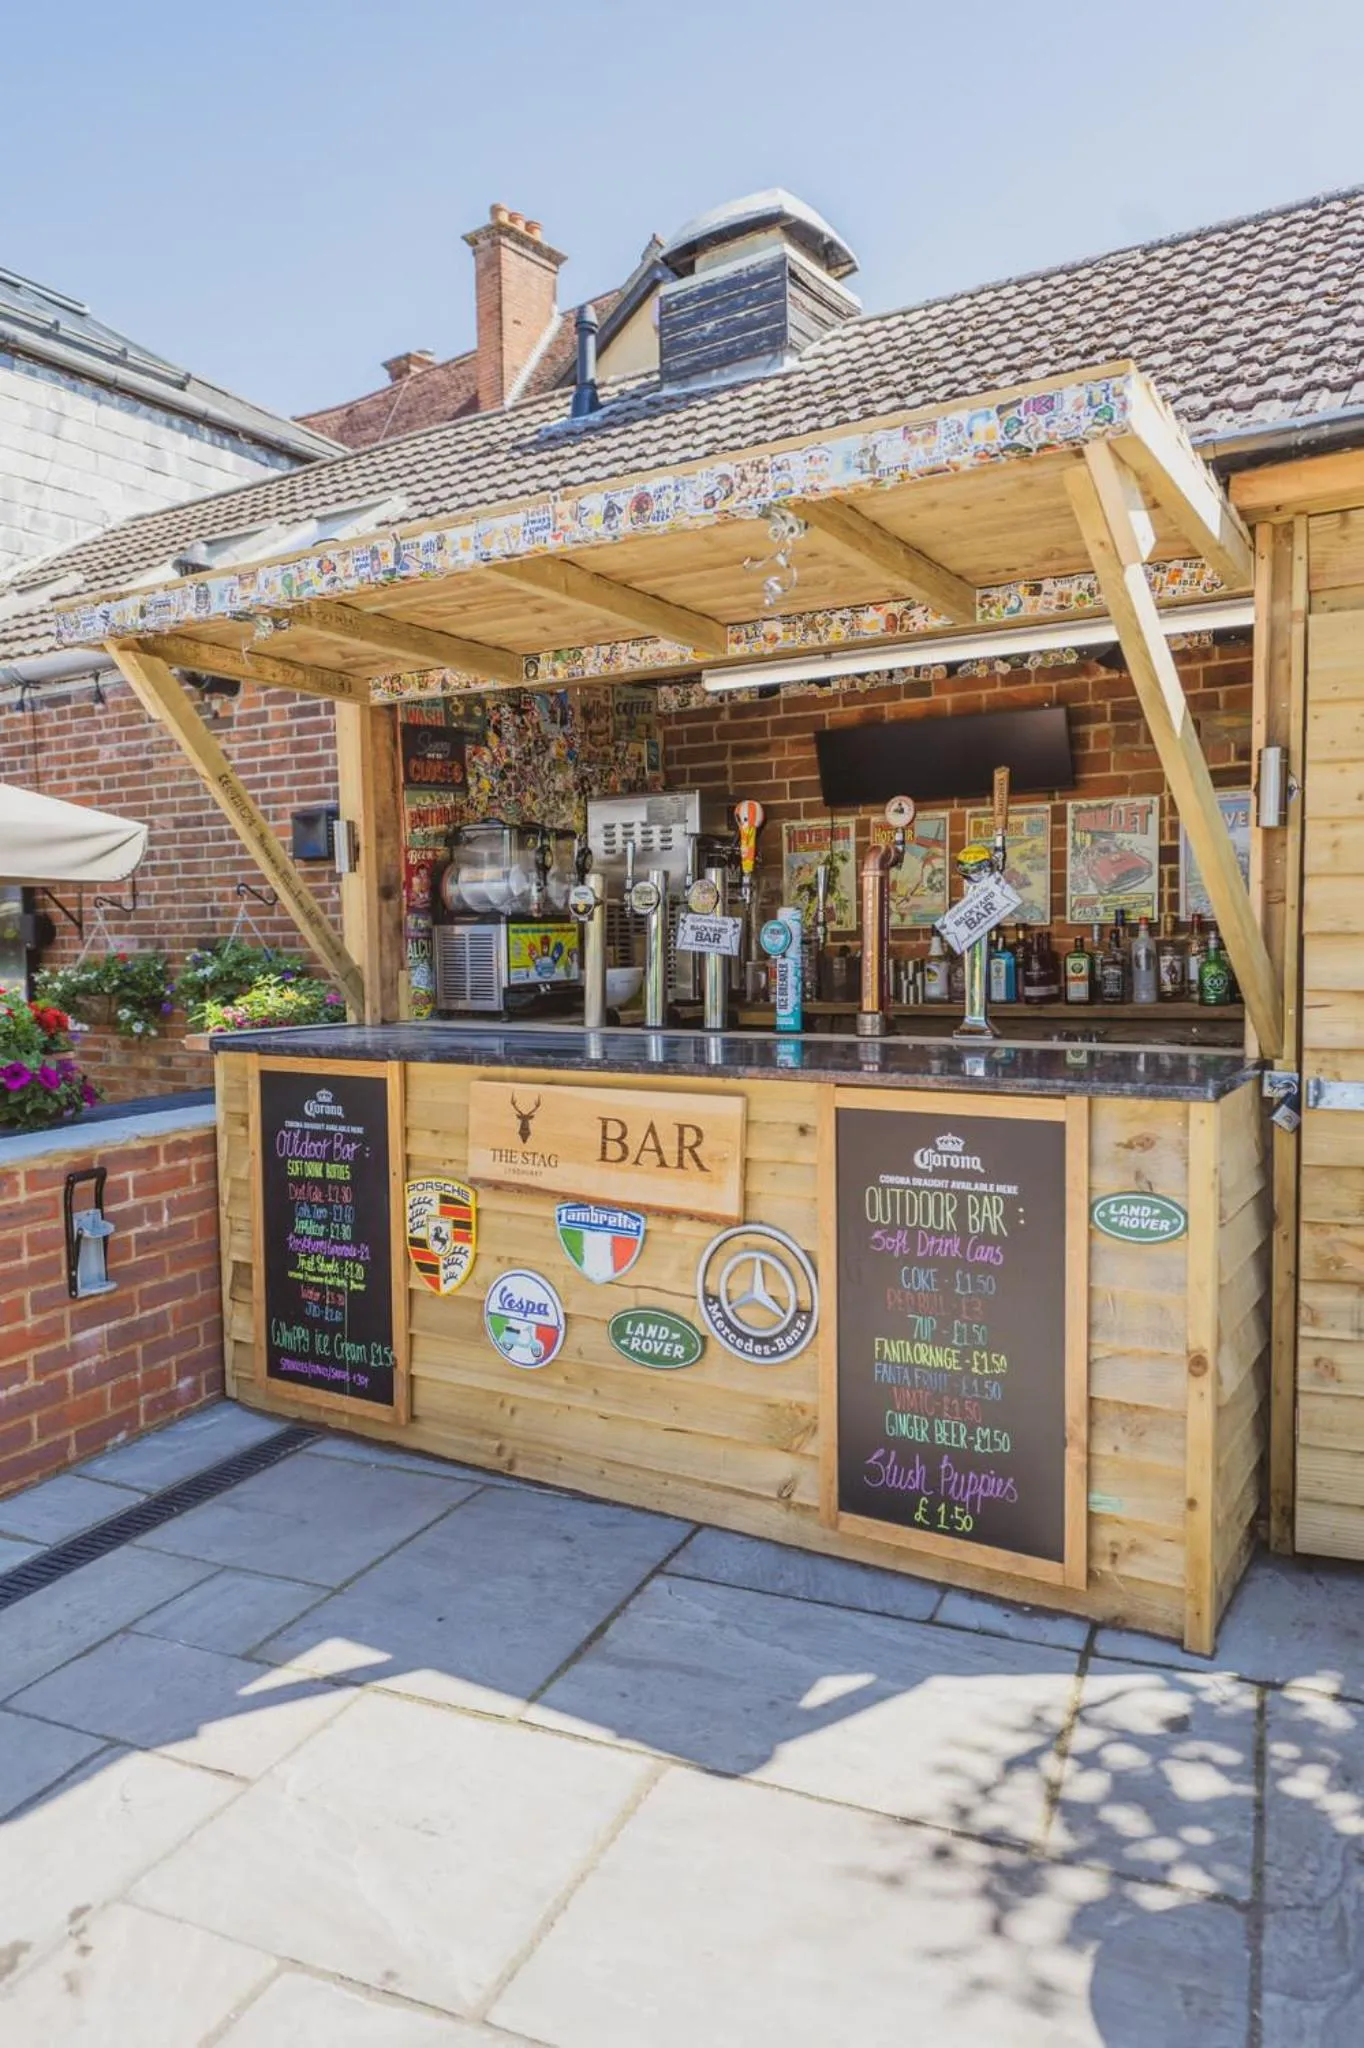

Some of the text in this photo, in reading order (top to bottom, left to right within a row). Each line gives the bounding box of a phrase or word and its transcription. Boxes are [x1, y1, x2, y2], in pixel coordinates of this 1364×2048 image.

[964, 902, 998, 931] BAR
[694, 930, 722, 944] BAR
[303, 1099, 345, 1118] Corona
[597, 1115, 712, 1172] BAR
[489, 1148, 560, 1168] THE STAG
[913, 1147, 986, 1174] Corona
[406, 1180, 471, 1202] PORSCHE
[878, 1174, 1020, 1196] CORONA DRAUGHT AVAILABLE HERE
[865, 1186, 958, 1232] OUTDOOR
[968, 1193, 1009, 1238] BAR
[1108, 1203, 1152, 1218] LAND
[1118, 1215, 1171, 1231] ROVER
[869, 1229, 911, 1258] Soft
[965, 1235, 1004, 1266] Cans
[901, 1266, 940, 1292] COKE
[497, 1286, 550, 1318] Vespa
[625, 1320, 670, 1341] LAND
[706, 1300, 807, 1356] Mercedes-Benz
[906, 1314, 937, 1342] 7UP
[630, 1338, 686, 1360] ROVER
[874, 1362, 911, 1387] FANTA
[885, 1410, 930, 1444] GINGER
[863, 1447, 1019, 1515] Slush Puppies
